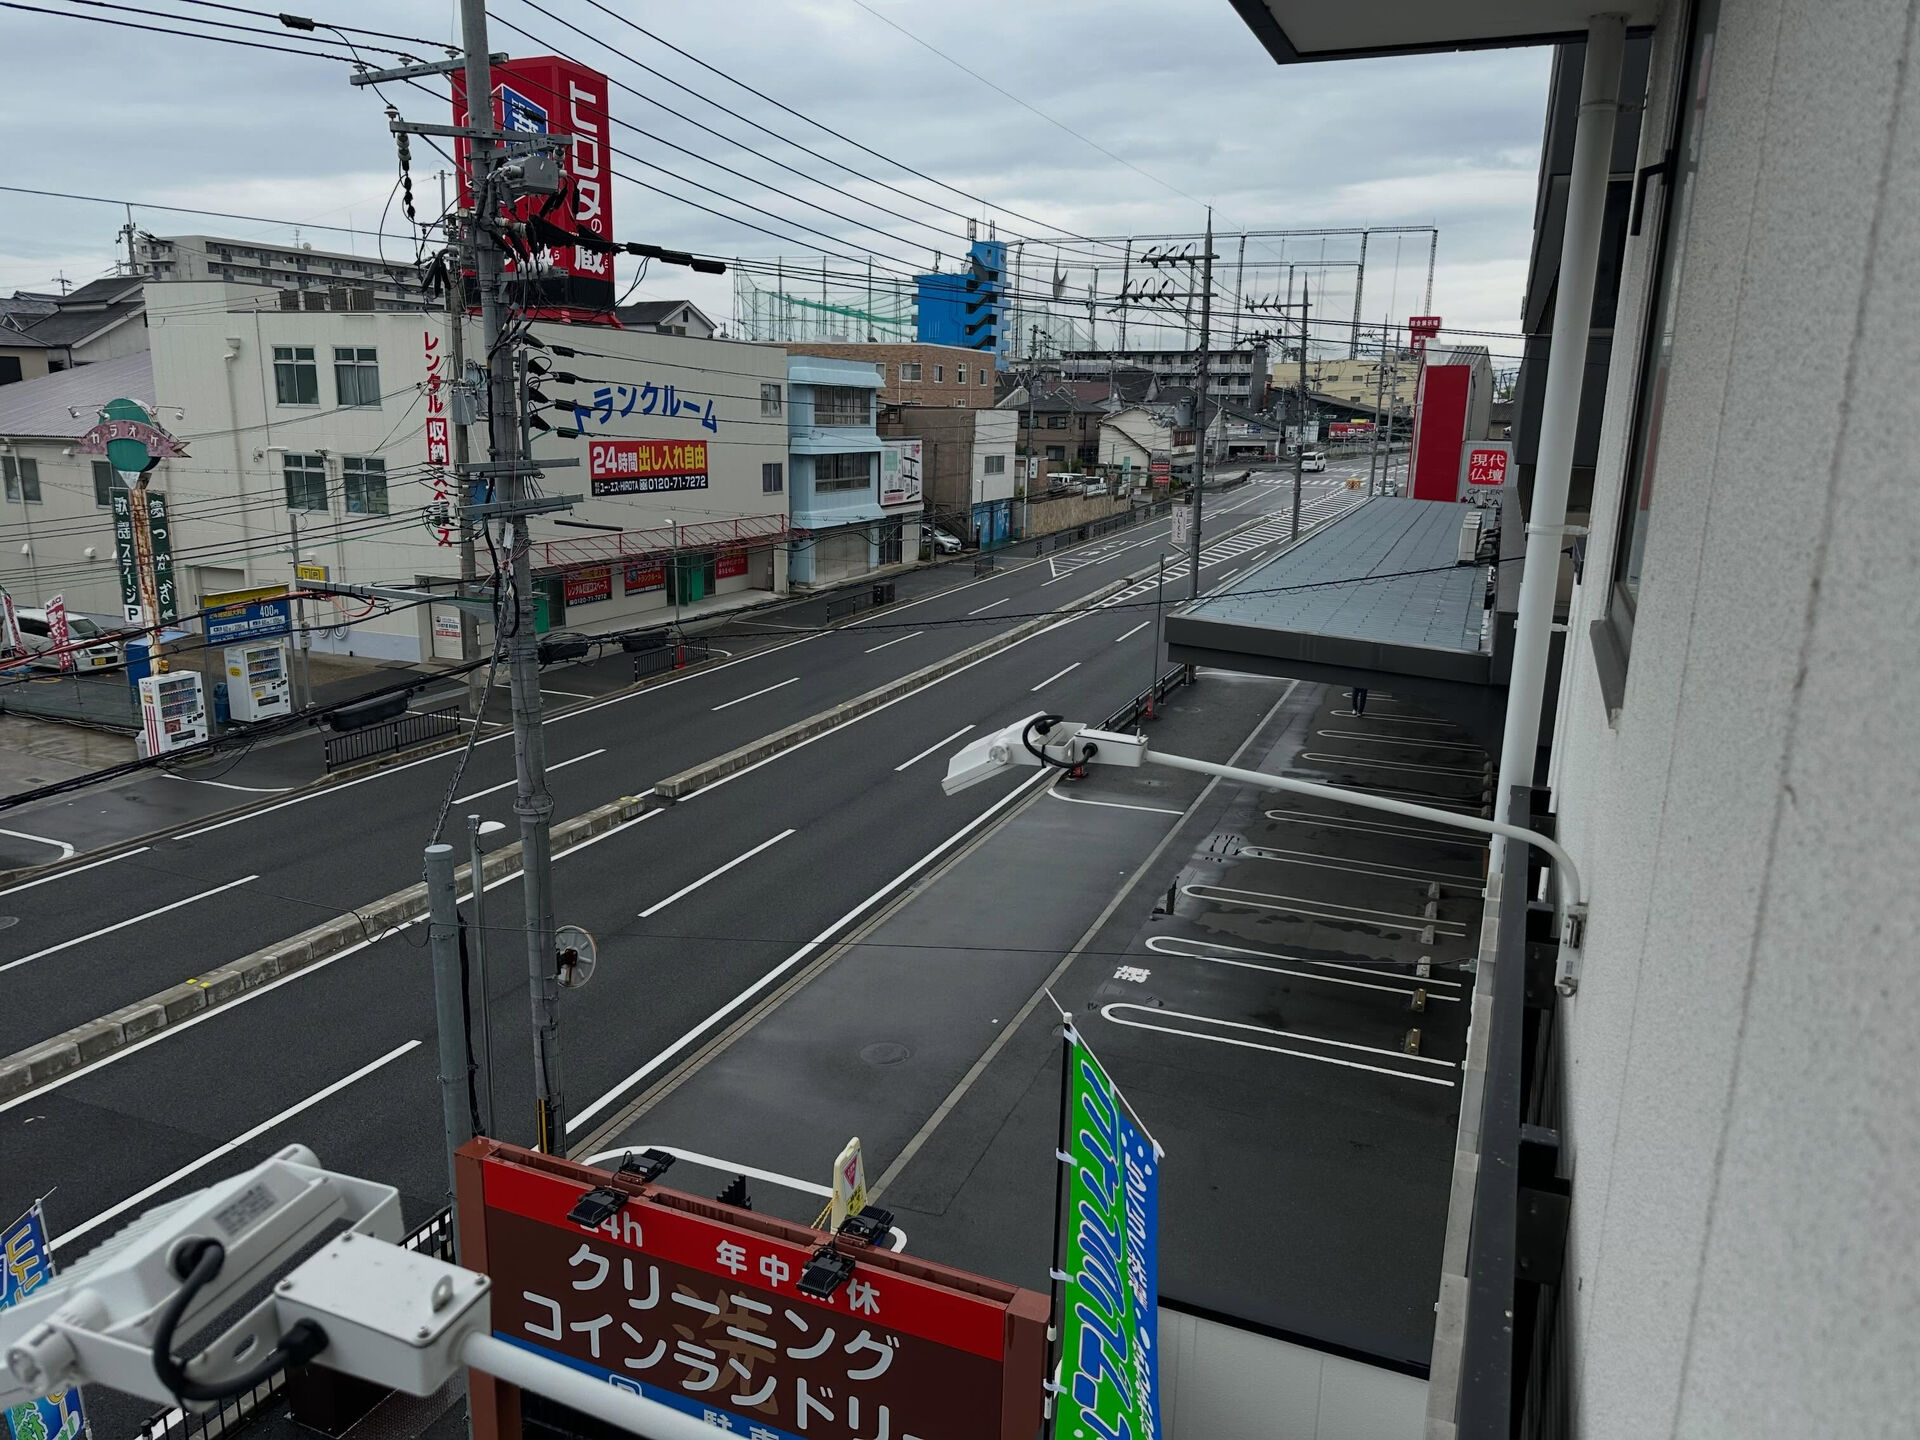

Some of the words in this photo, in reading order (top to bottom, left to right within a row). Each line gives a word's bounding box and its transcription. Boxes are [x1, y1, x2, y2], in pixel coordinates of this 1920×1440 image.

[573, 381, 717, 433] トランクルーム
[91, 424, 159, 448] カラオケ
[593, 444, 706, 475] 24時間出し入れ自由
[1471, 453, 1506, 467] 現代
[1470, 467, 1504, 482] 仏壇
[128, 607, 139, 621] P
[1112, 965, 1151, 984] 軽
[580, 1210, 643, 1248] 4h
[716, 1239, 880, 1316] 年中休
[568, 1243, 900, 1381] クリーニング
[523, 1290, 926, 1440] コインランドリ
